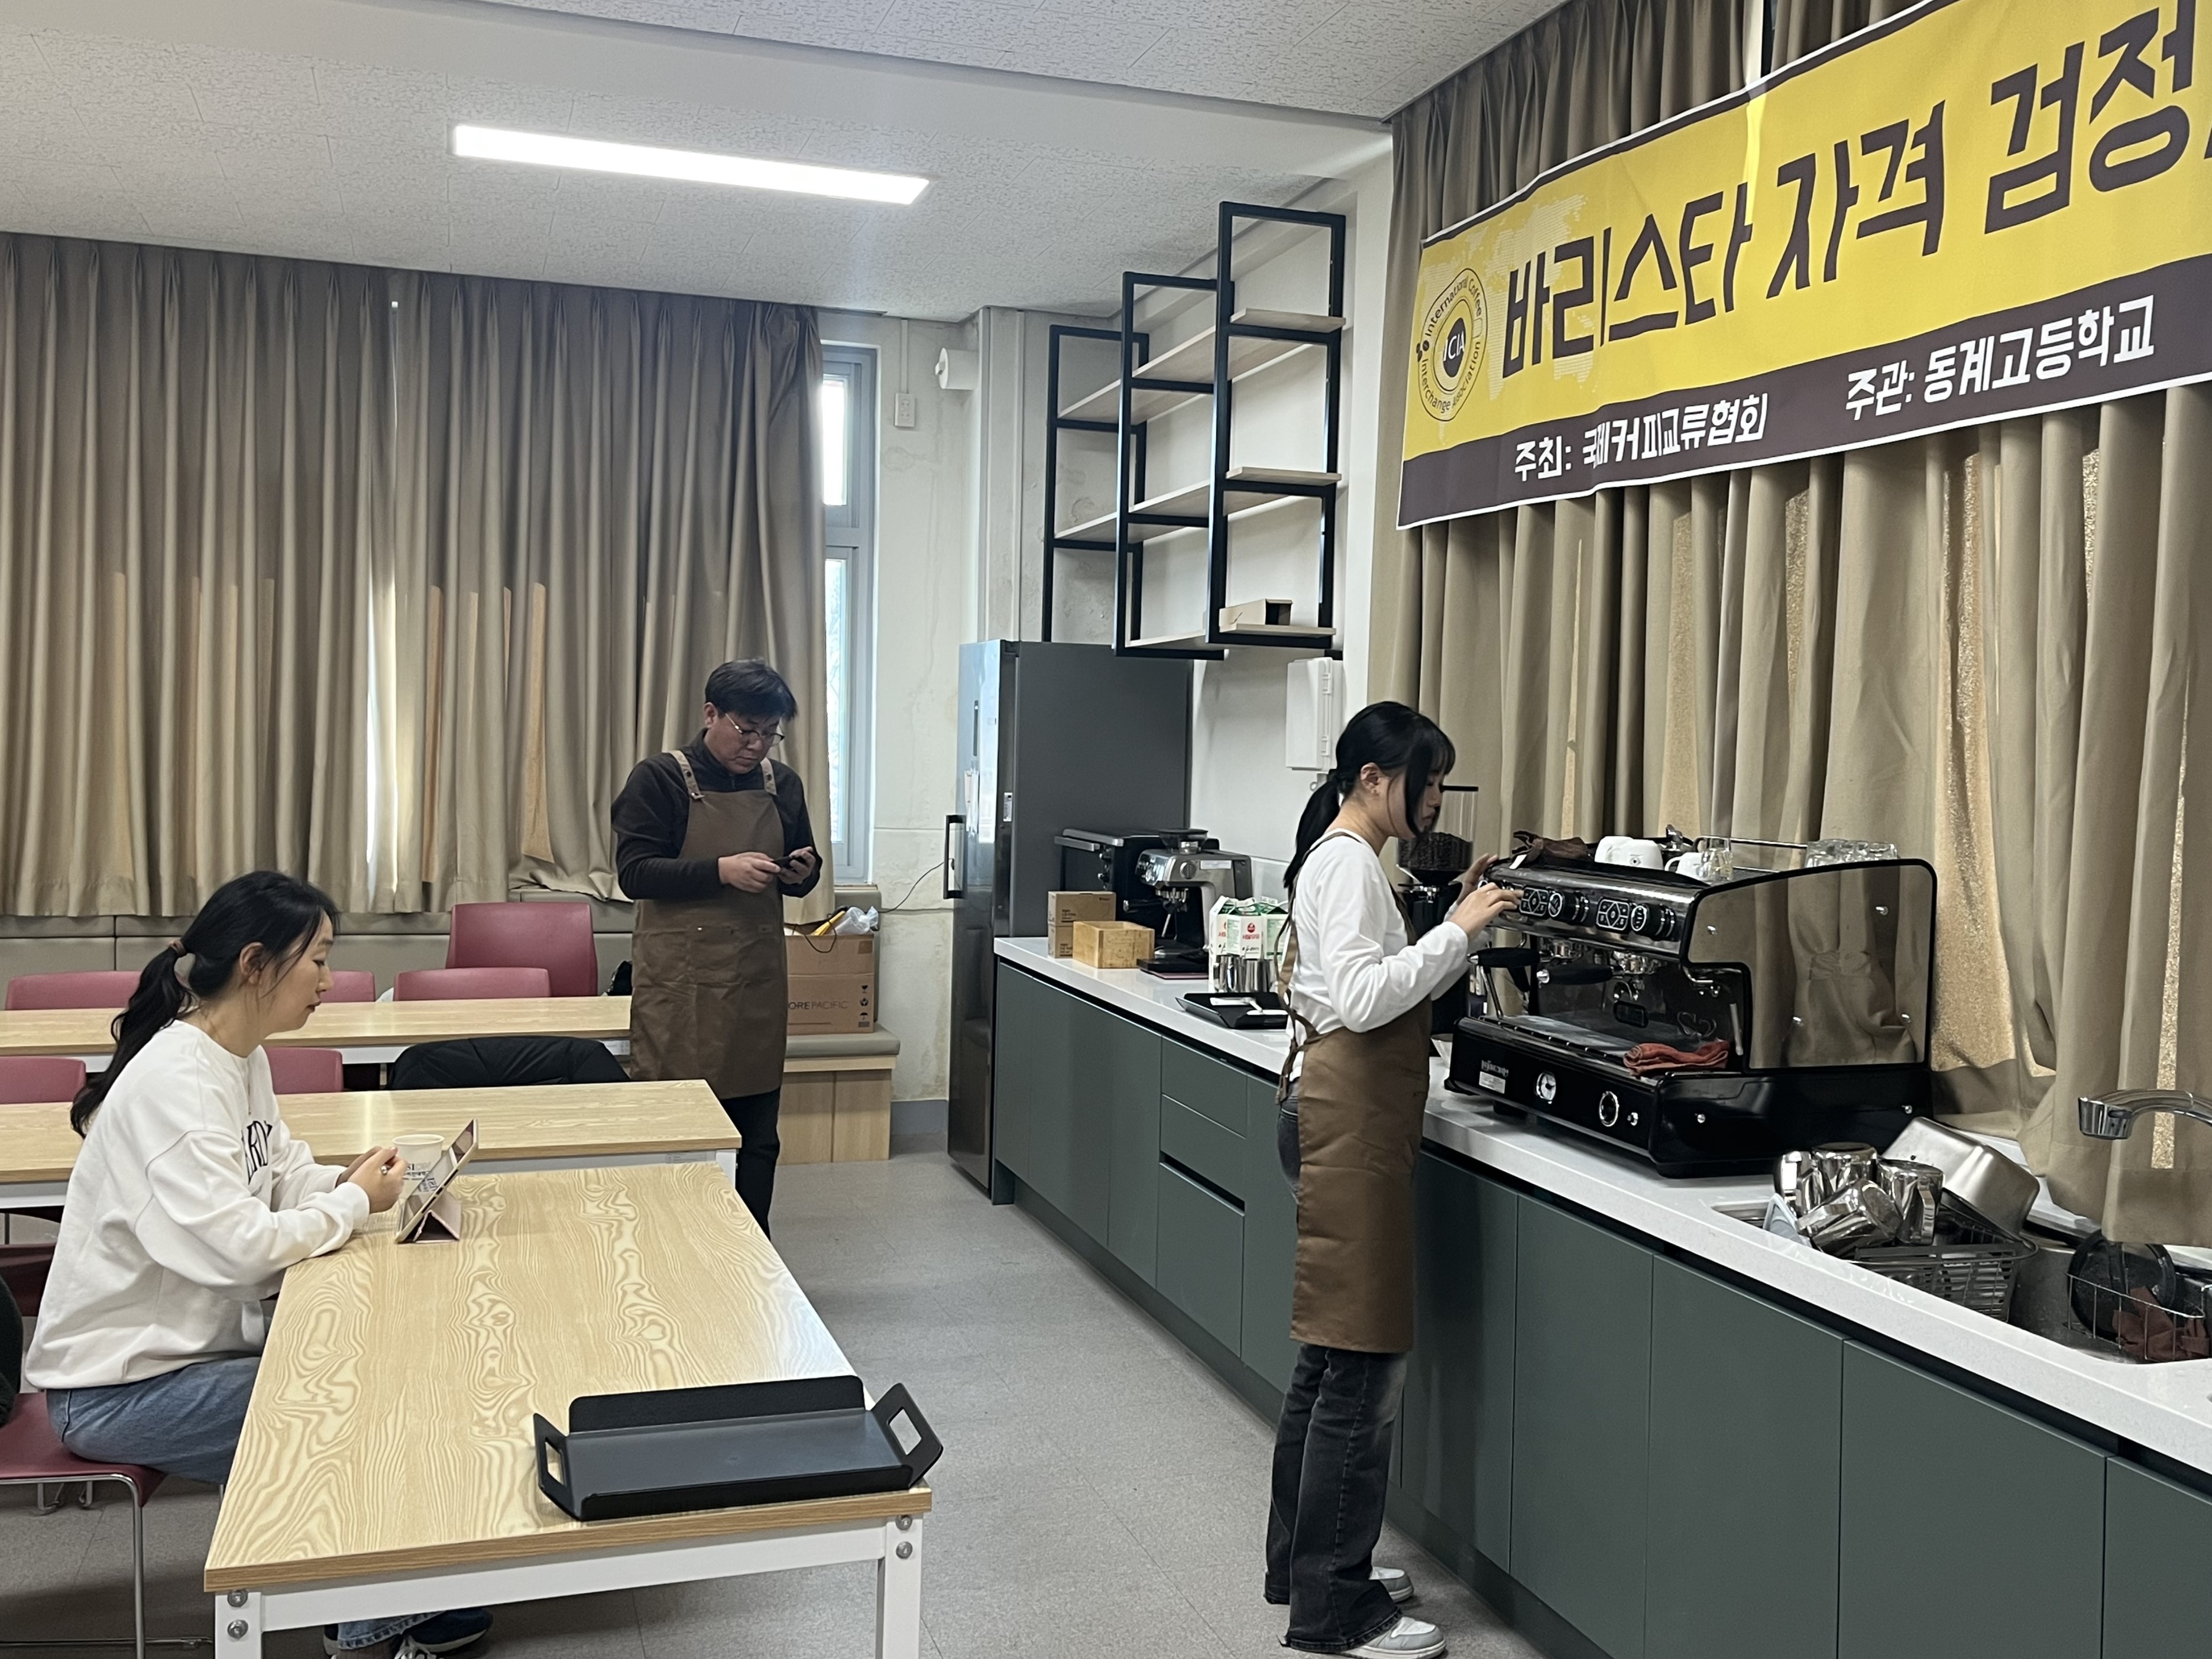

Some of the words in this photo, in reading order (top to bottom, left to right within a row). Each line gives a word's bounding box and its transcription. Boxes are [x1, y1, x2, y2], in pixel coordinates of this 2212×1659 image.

[1502, 182, 1753, 379] 바리스타
[1766, 99, 1946, 299] 자격
[1984, 0, 2212, 235] 검정
[1469, 278, 1482, 317] Coffee
[1443, 330, 1465, 362] ICIA
[1923, 294, 2154, 403] 동계고등학교
[1421, 358, 1451, 414] Interchange
[1514, 436, 1572, 482] 주최:
